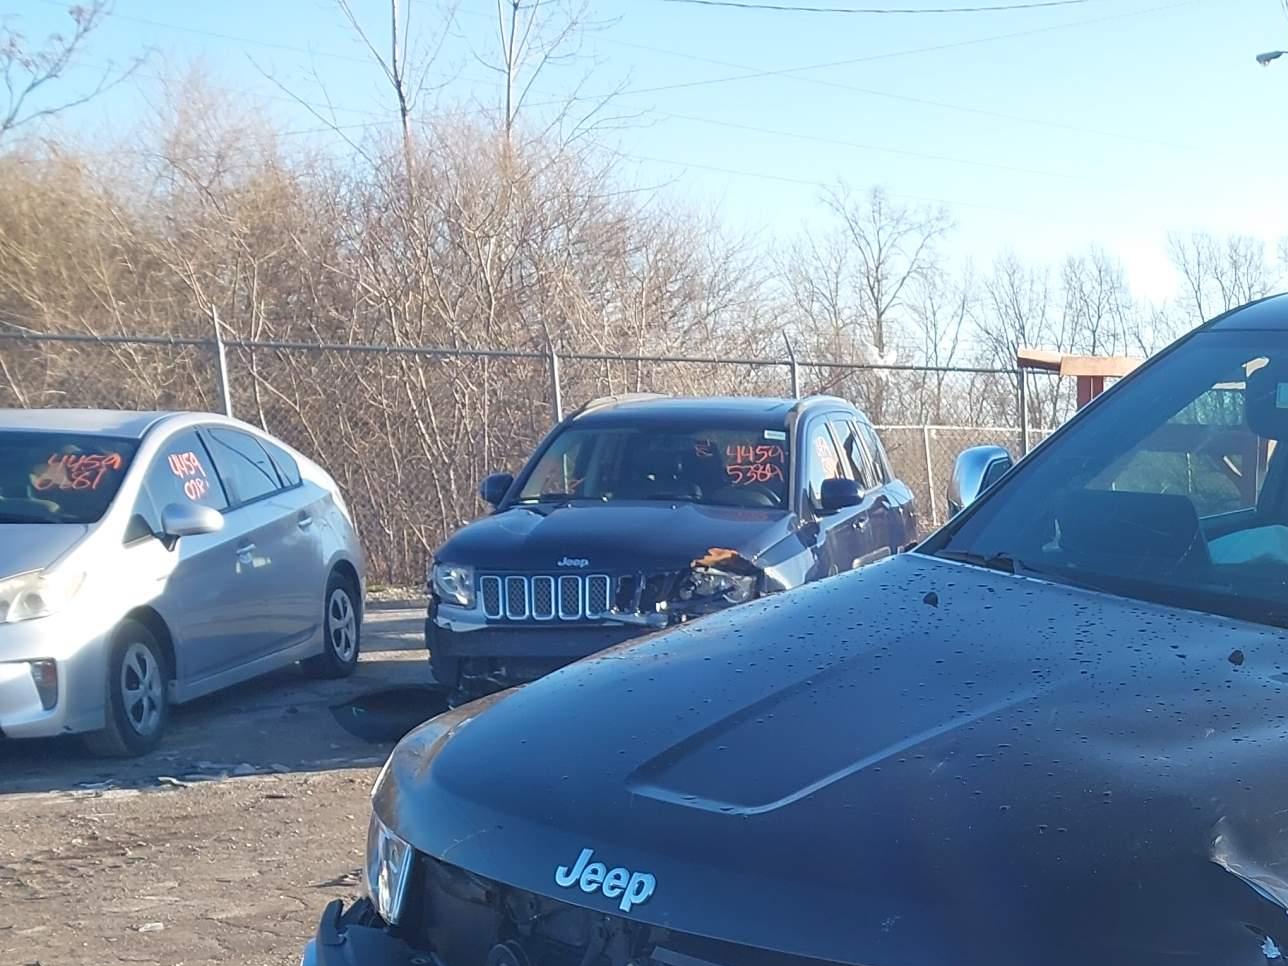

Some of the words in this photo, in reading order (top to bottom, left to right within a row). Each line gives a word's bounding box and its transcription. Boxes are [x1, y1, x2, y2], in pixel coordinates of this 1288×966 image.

[167, 451, 206, 479] 4459
[557, 556, 589, 569] Jeep
[555, 848, 657, 912] Jeep
